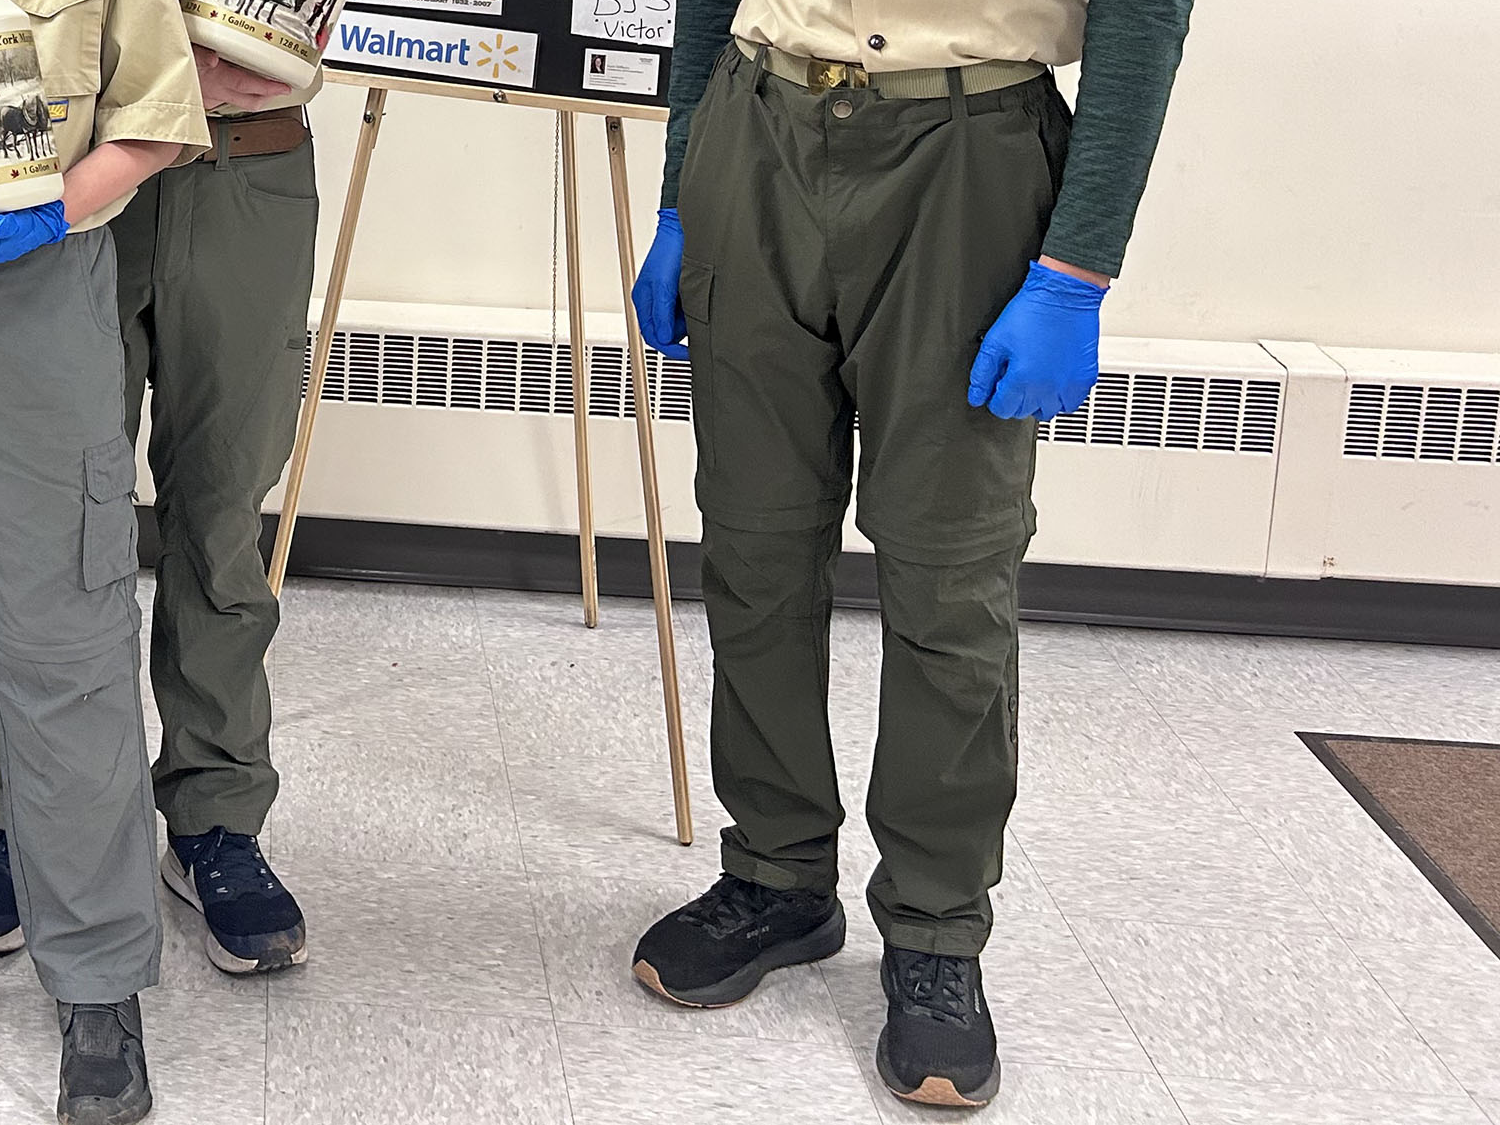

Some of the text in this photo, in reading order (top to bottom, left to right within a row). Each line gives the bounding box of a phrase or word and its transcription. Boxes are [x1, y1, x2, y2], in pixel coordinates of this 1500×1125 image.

[221, 13, 256, 33] 1 Gallon
[279, 37, 294, 50] 128
[339, 23, 471, 66] Walmart
[23, 162, 51, 175] 1 Gallon
